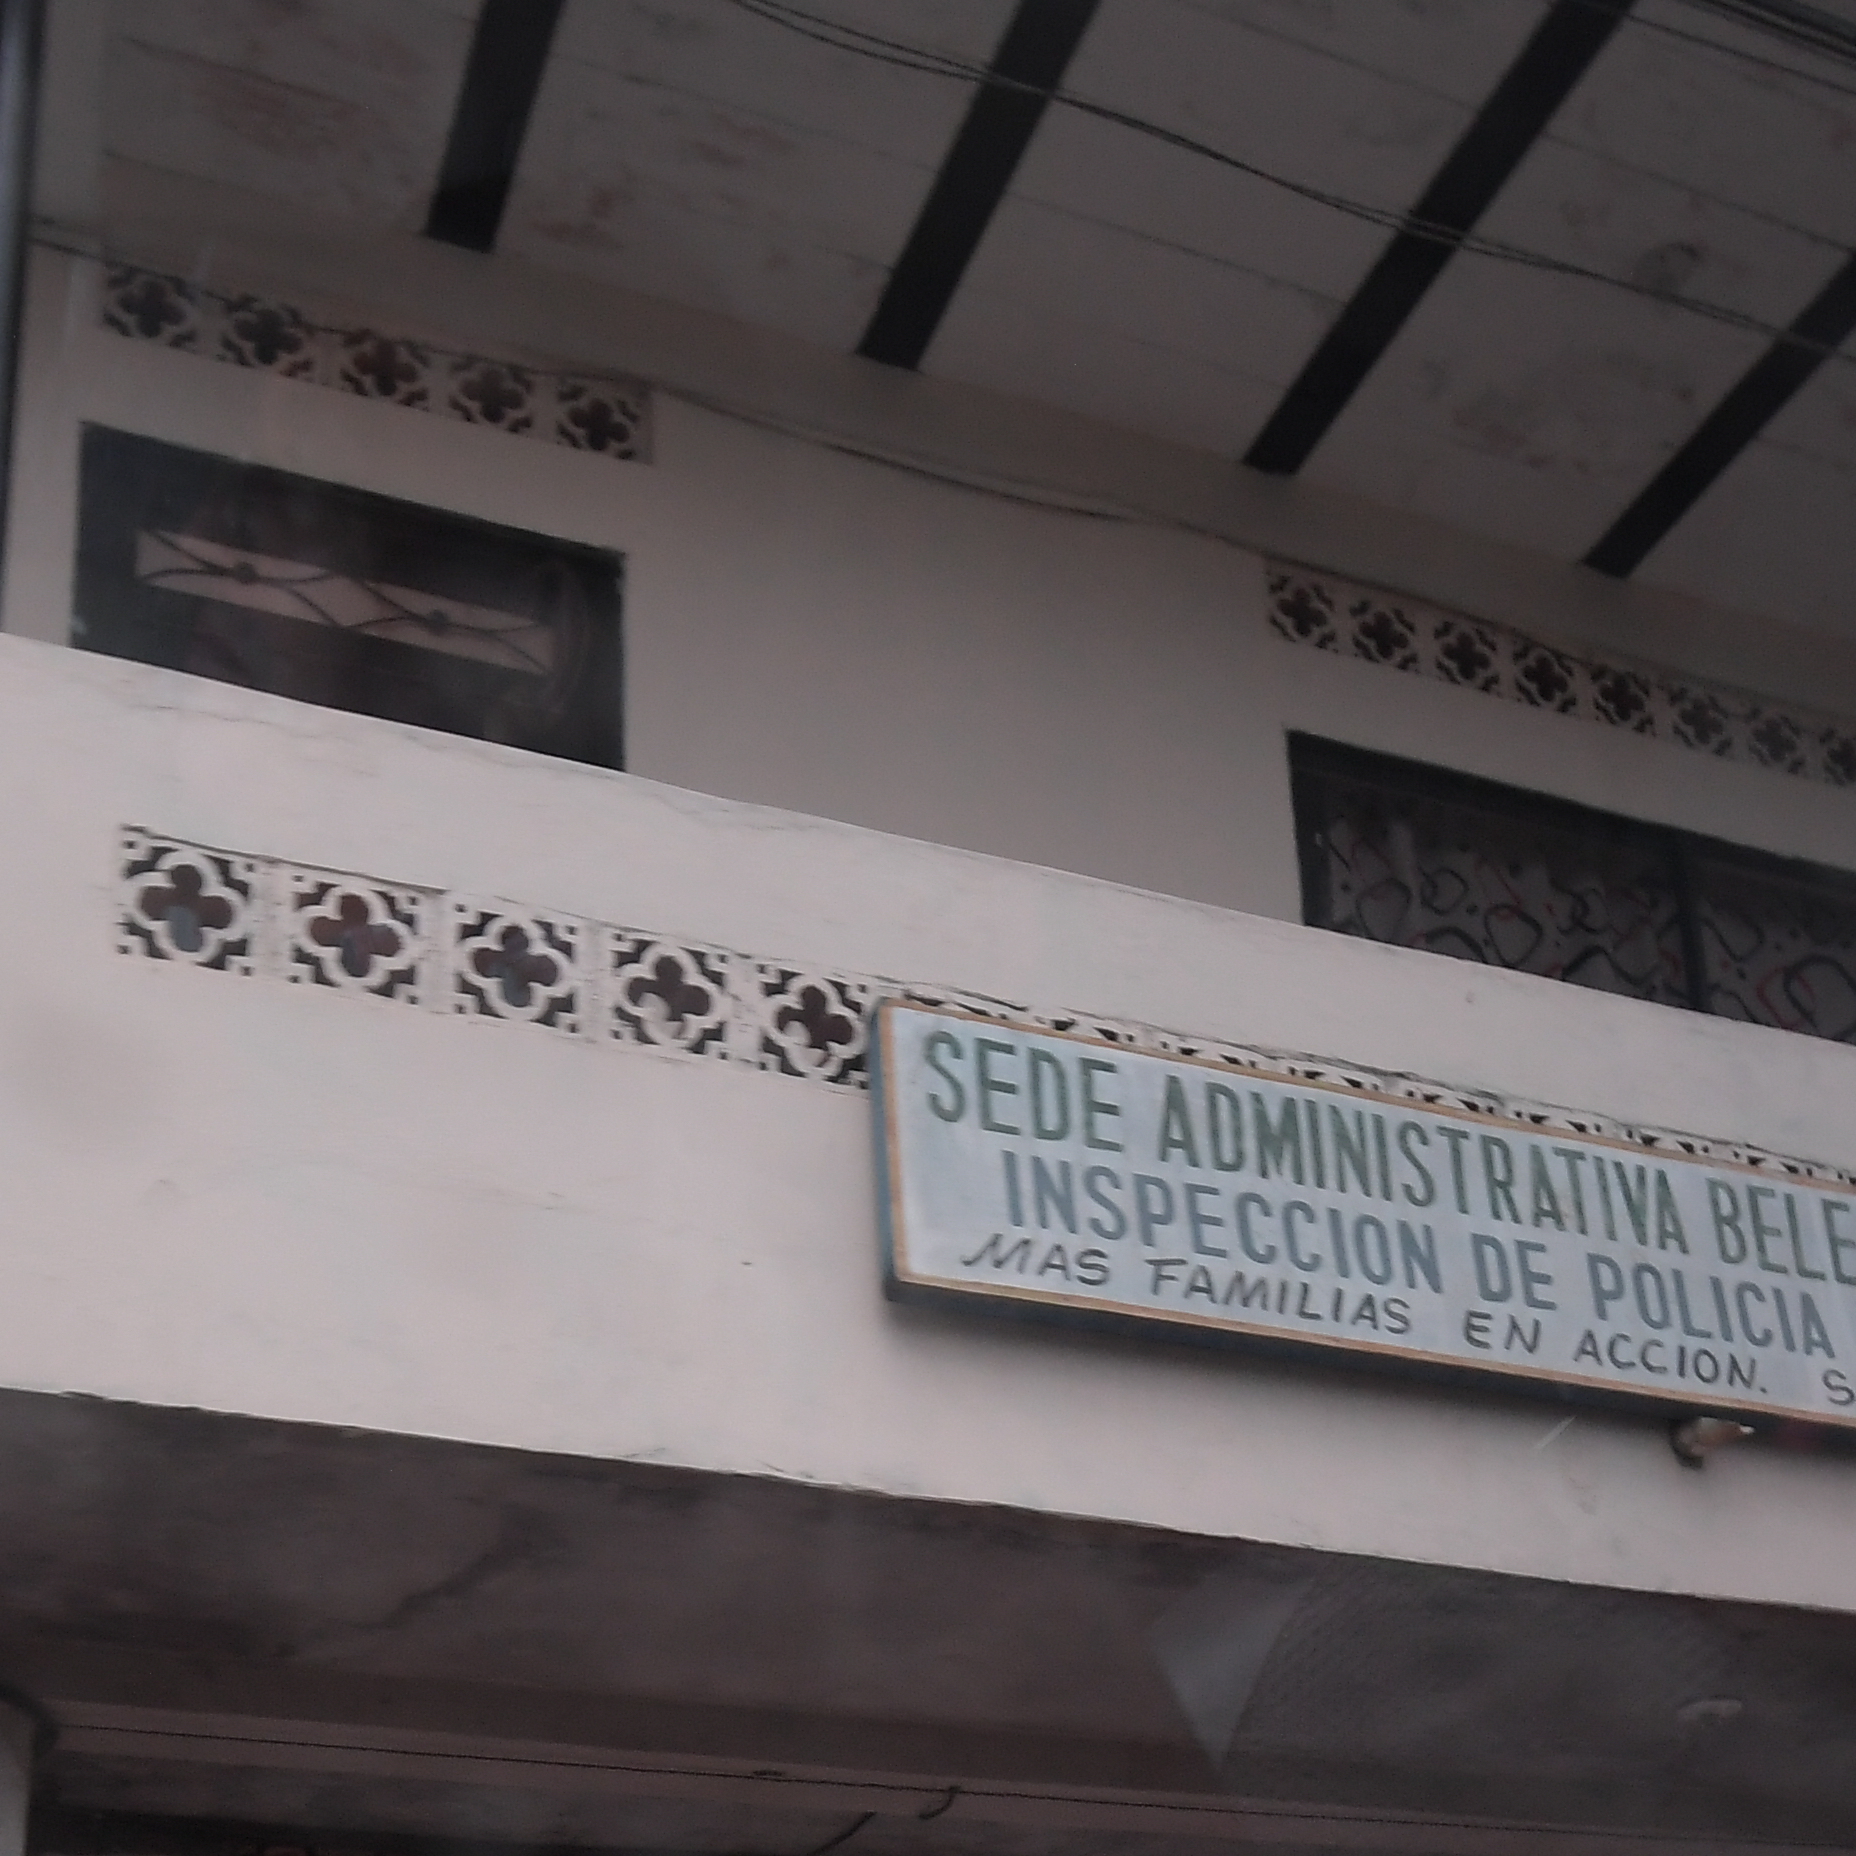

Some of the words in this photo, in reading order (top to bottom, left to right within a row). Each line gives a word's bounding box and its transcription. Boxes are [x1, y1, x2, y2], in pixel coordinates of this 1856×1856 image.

[923, 1030, 1124, 1154] SEDE
[1157, 1073, 1691, 1256] ADMINISTRATIVA
[960, 1231, 1112, 1287] MAS
[1144, 1256, 1412, 1336] FAMILIAS
[1462, 1309, 1542, 1355] EN
[1001, 1149, 1442, 1295] INSPECCION
[1471, 1232, 1558, 1312] DE
[1586, 1251, 1837, 1360] POLICIA
